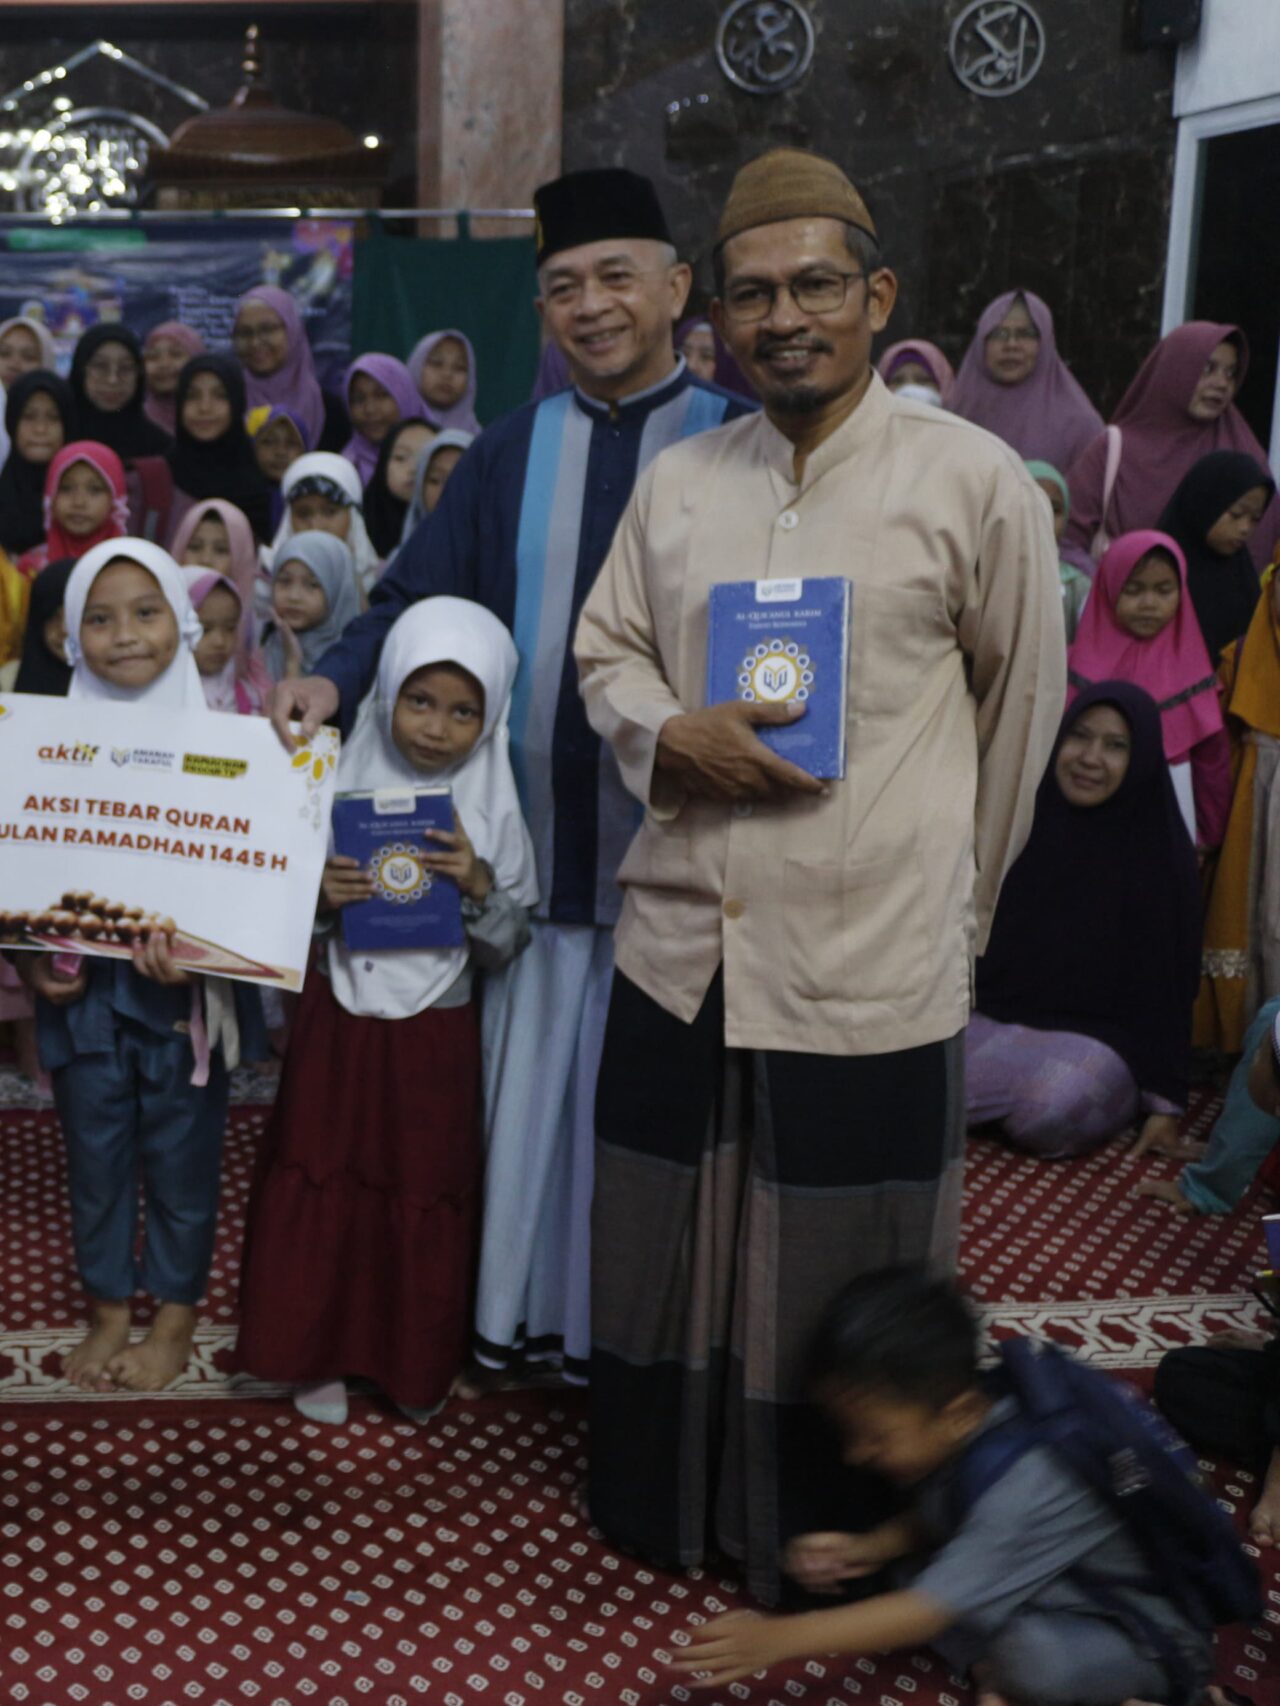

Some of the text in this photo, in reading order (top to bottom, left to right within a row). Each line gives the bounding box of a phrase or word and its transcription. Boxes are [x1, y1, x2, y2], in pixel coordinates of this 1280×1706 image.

[37, 743, 100, 763] aktif
[23, 795, 250, 835] AKSI TEBAR QURAN
[63, 828, 205, 859] RAMADHAN
[211, 844, 266, 868] 1445
[271, 854, 287, 871] H
